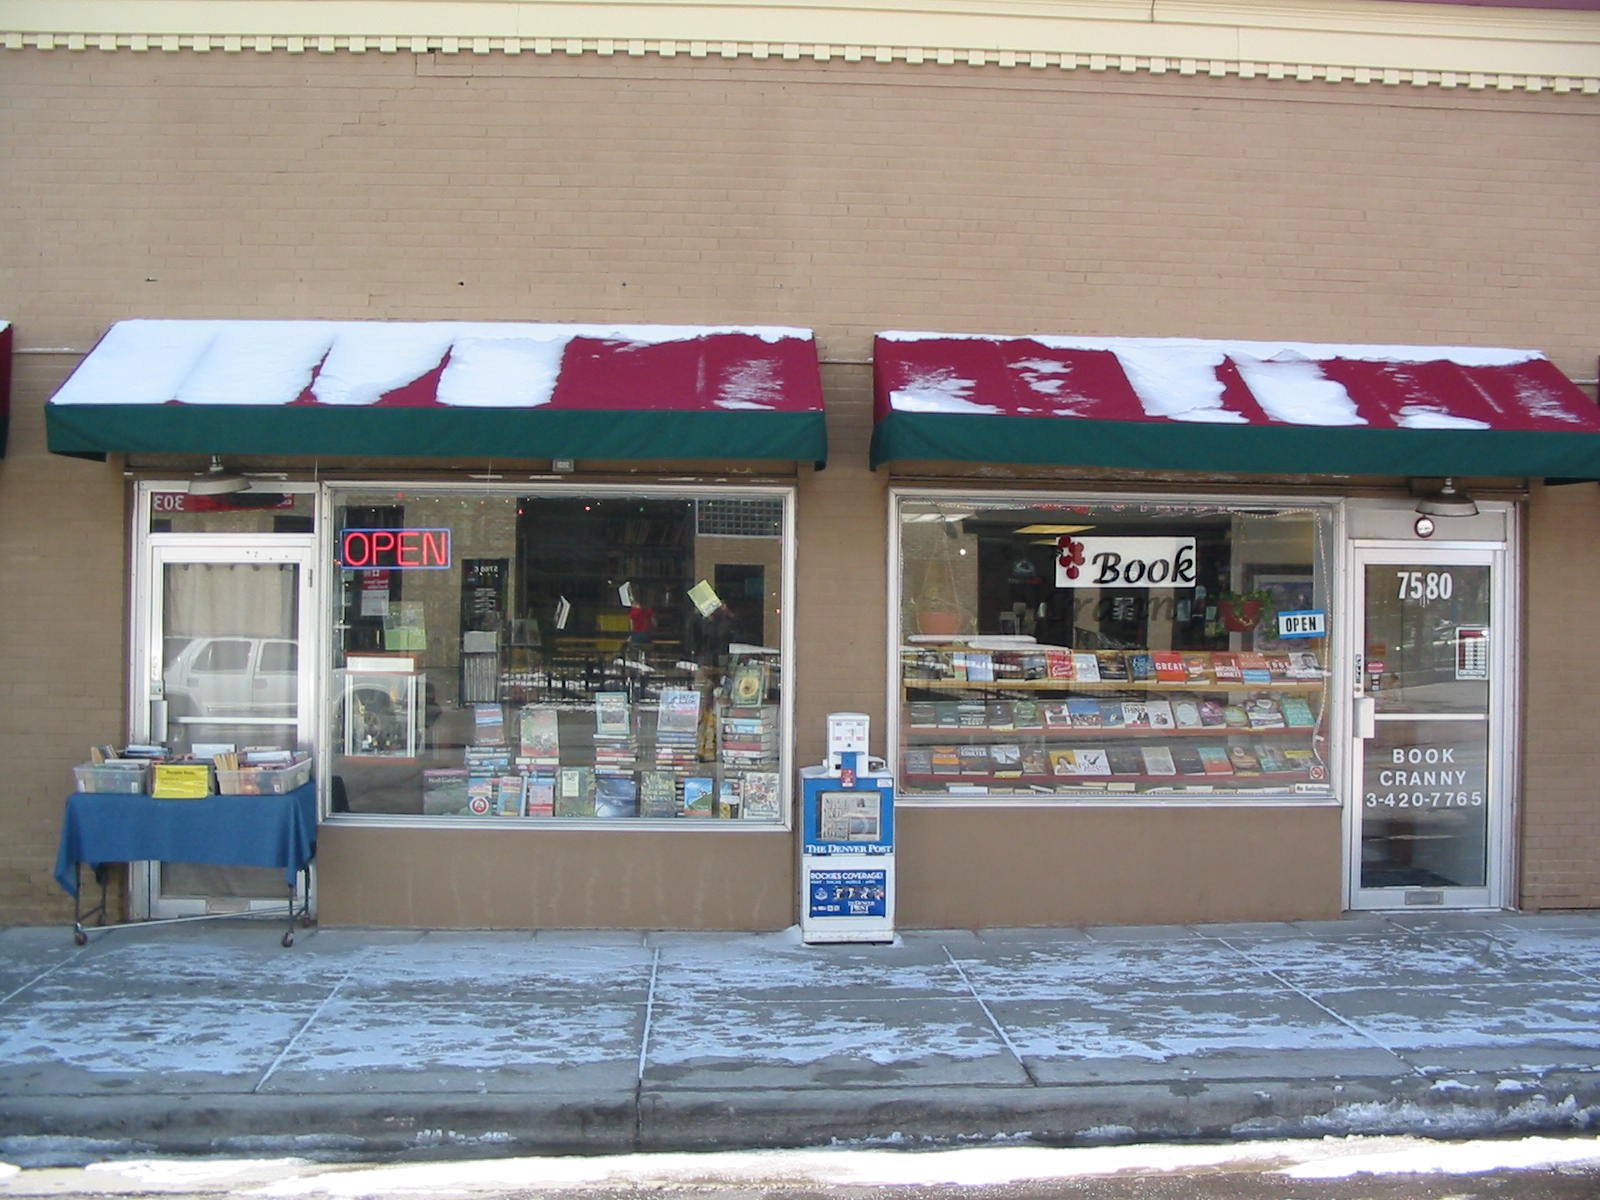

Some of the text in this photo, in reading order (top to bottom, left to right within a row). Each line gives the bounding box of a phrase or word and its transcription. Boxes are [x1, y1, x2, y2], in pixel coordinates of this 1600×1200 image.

[344, 531, 447, 566] OPEN
[1091, 545, 1196, 585] Book
[1397, 571, 1453, 600] 7580
[1285, 616, 1318, 633] OPEN
[1393, 748, 1455, 764] BOOK
[1379, 771, 1467, 787] CRANNY
[1366, 792, 1482, 808] 3-420-7765
[805, 844, 893, 854] THE DENVER POST
